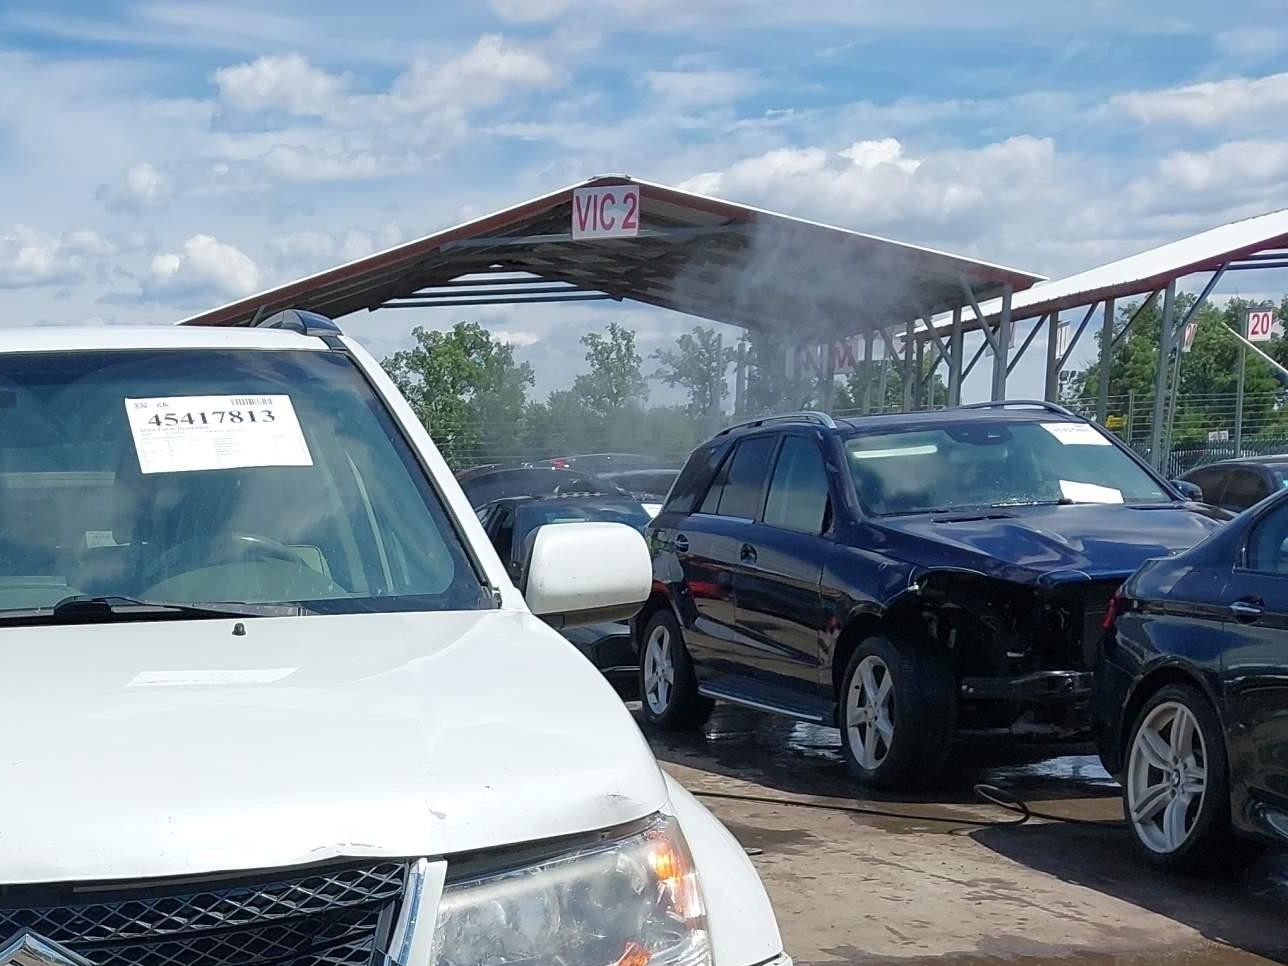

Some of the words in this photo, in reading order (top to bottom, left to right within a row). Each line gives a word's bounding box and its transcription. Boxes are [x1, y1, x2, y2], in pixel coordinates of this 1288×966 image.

[575, 193, 616, 232] VIC
[621, 192, 638, 229] 2
[1250, 313, 1270, 335] 20
[147, 409, 276, 427] 45417813
